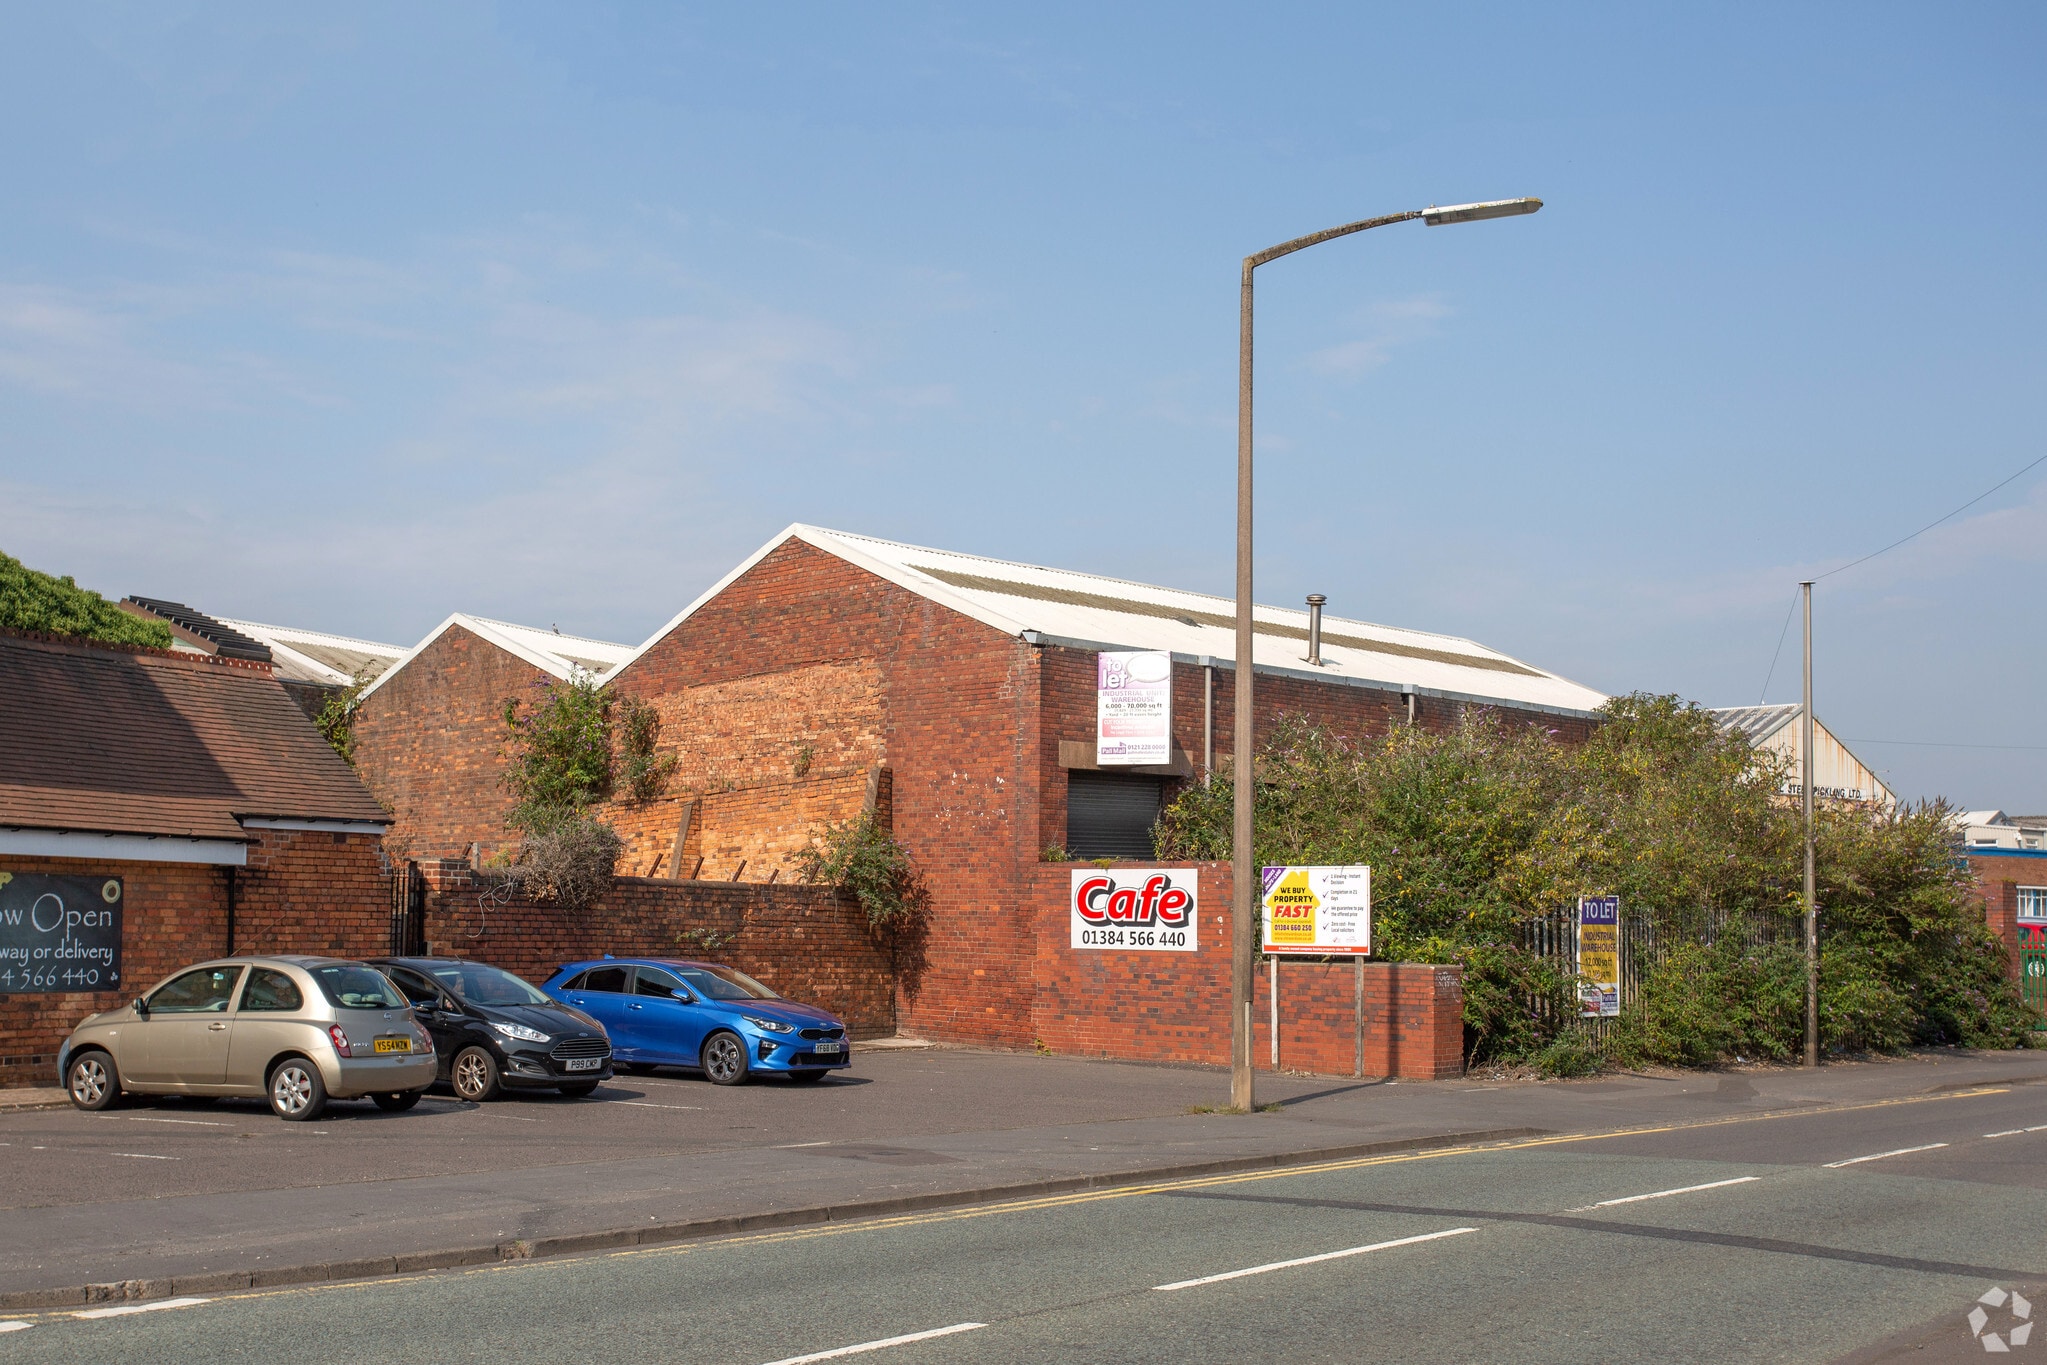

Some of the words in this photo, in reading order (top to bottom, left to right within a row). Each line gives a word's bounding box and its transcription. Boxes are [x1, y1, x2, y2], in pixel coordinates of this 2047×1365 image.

[1106, 658, 1123, 672] to
[1102, 668, 1128, 689] let
[1075, 874, 1194, 928] Cafe
[1274, 895, 1314, 903] PROPERTY
[31, 893, 112, 942] Open
[1274, 904, 1313, 918] FAST
[1584, 902, 1598, 919] TO
[1600, 902, 1616, 919] LET
[1082, 930, 1124, 945] 01384
[1129, 931, 1155, 946] 566
[1159, 932, 1186, 947] 440
[1583, 931, 1615, 940] INDUSTRIAL
[33, 947, 51, 959] or
[54, 938, 113, 967] delivery
[1581, 943, 1616, 953] WAREHOUSE
[20, 965, 57, 990] 566
[62, 967, 99, 986] 440
